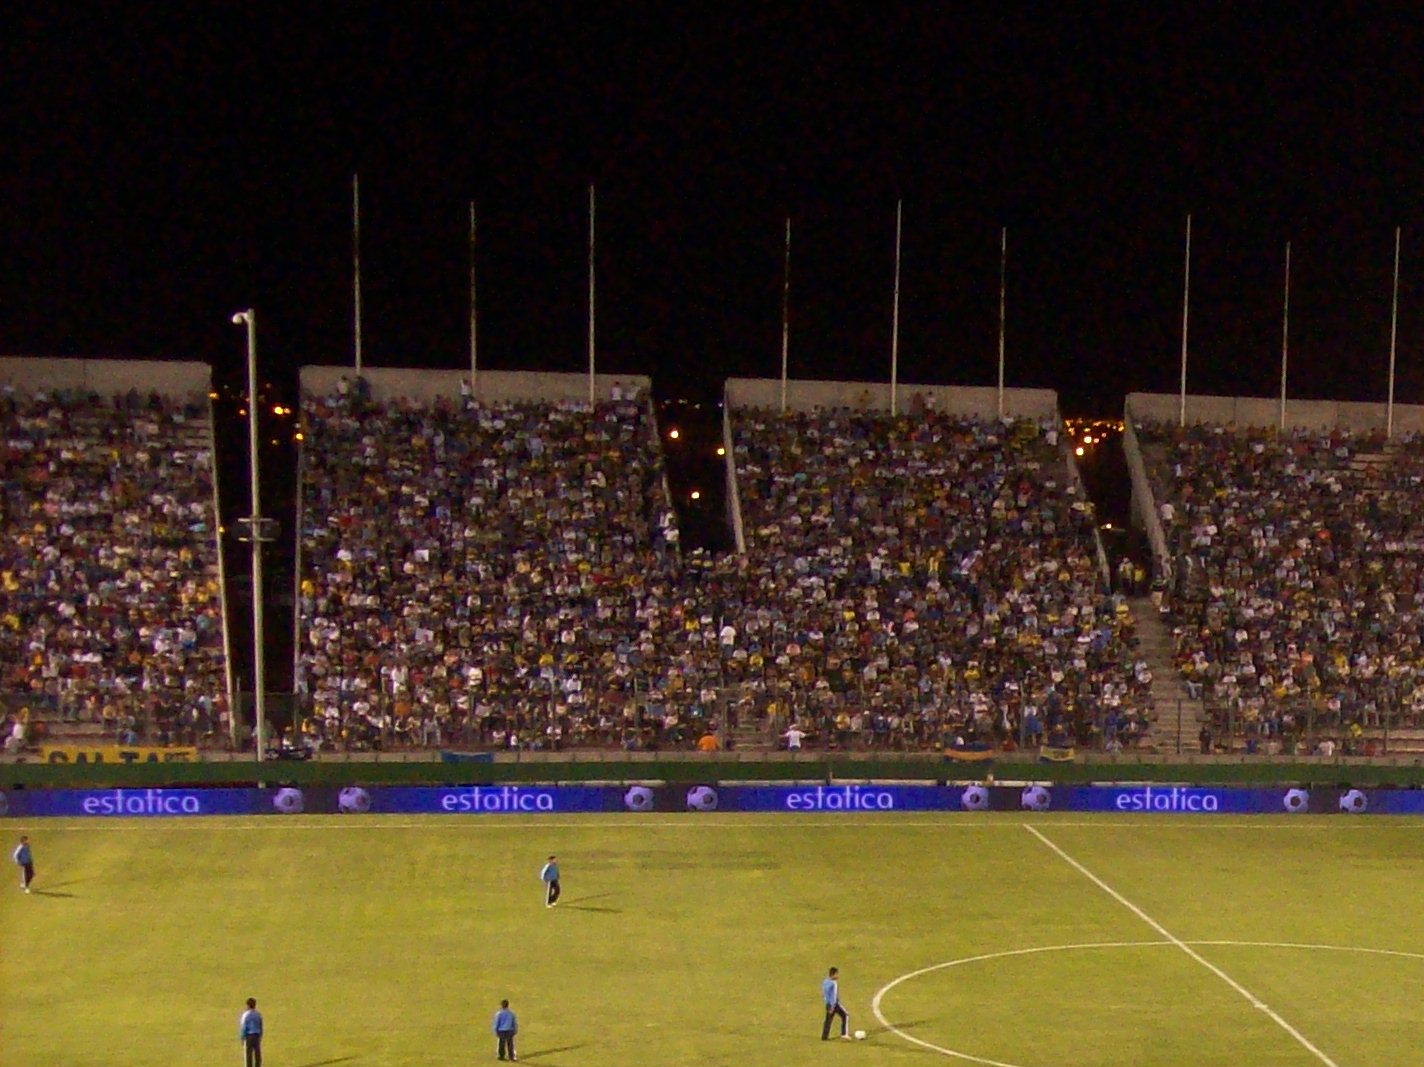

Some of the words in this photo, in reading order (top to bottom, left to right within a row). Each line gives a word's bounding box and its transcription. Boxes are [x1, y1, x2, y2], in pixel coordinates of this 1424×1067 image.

[83, 788, 200, 814] estatica
[442, 786, 554, 812] estatica
[786, 784, 894, 811] estatica
[1116, 785, 1218, 811] estatica
